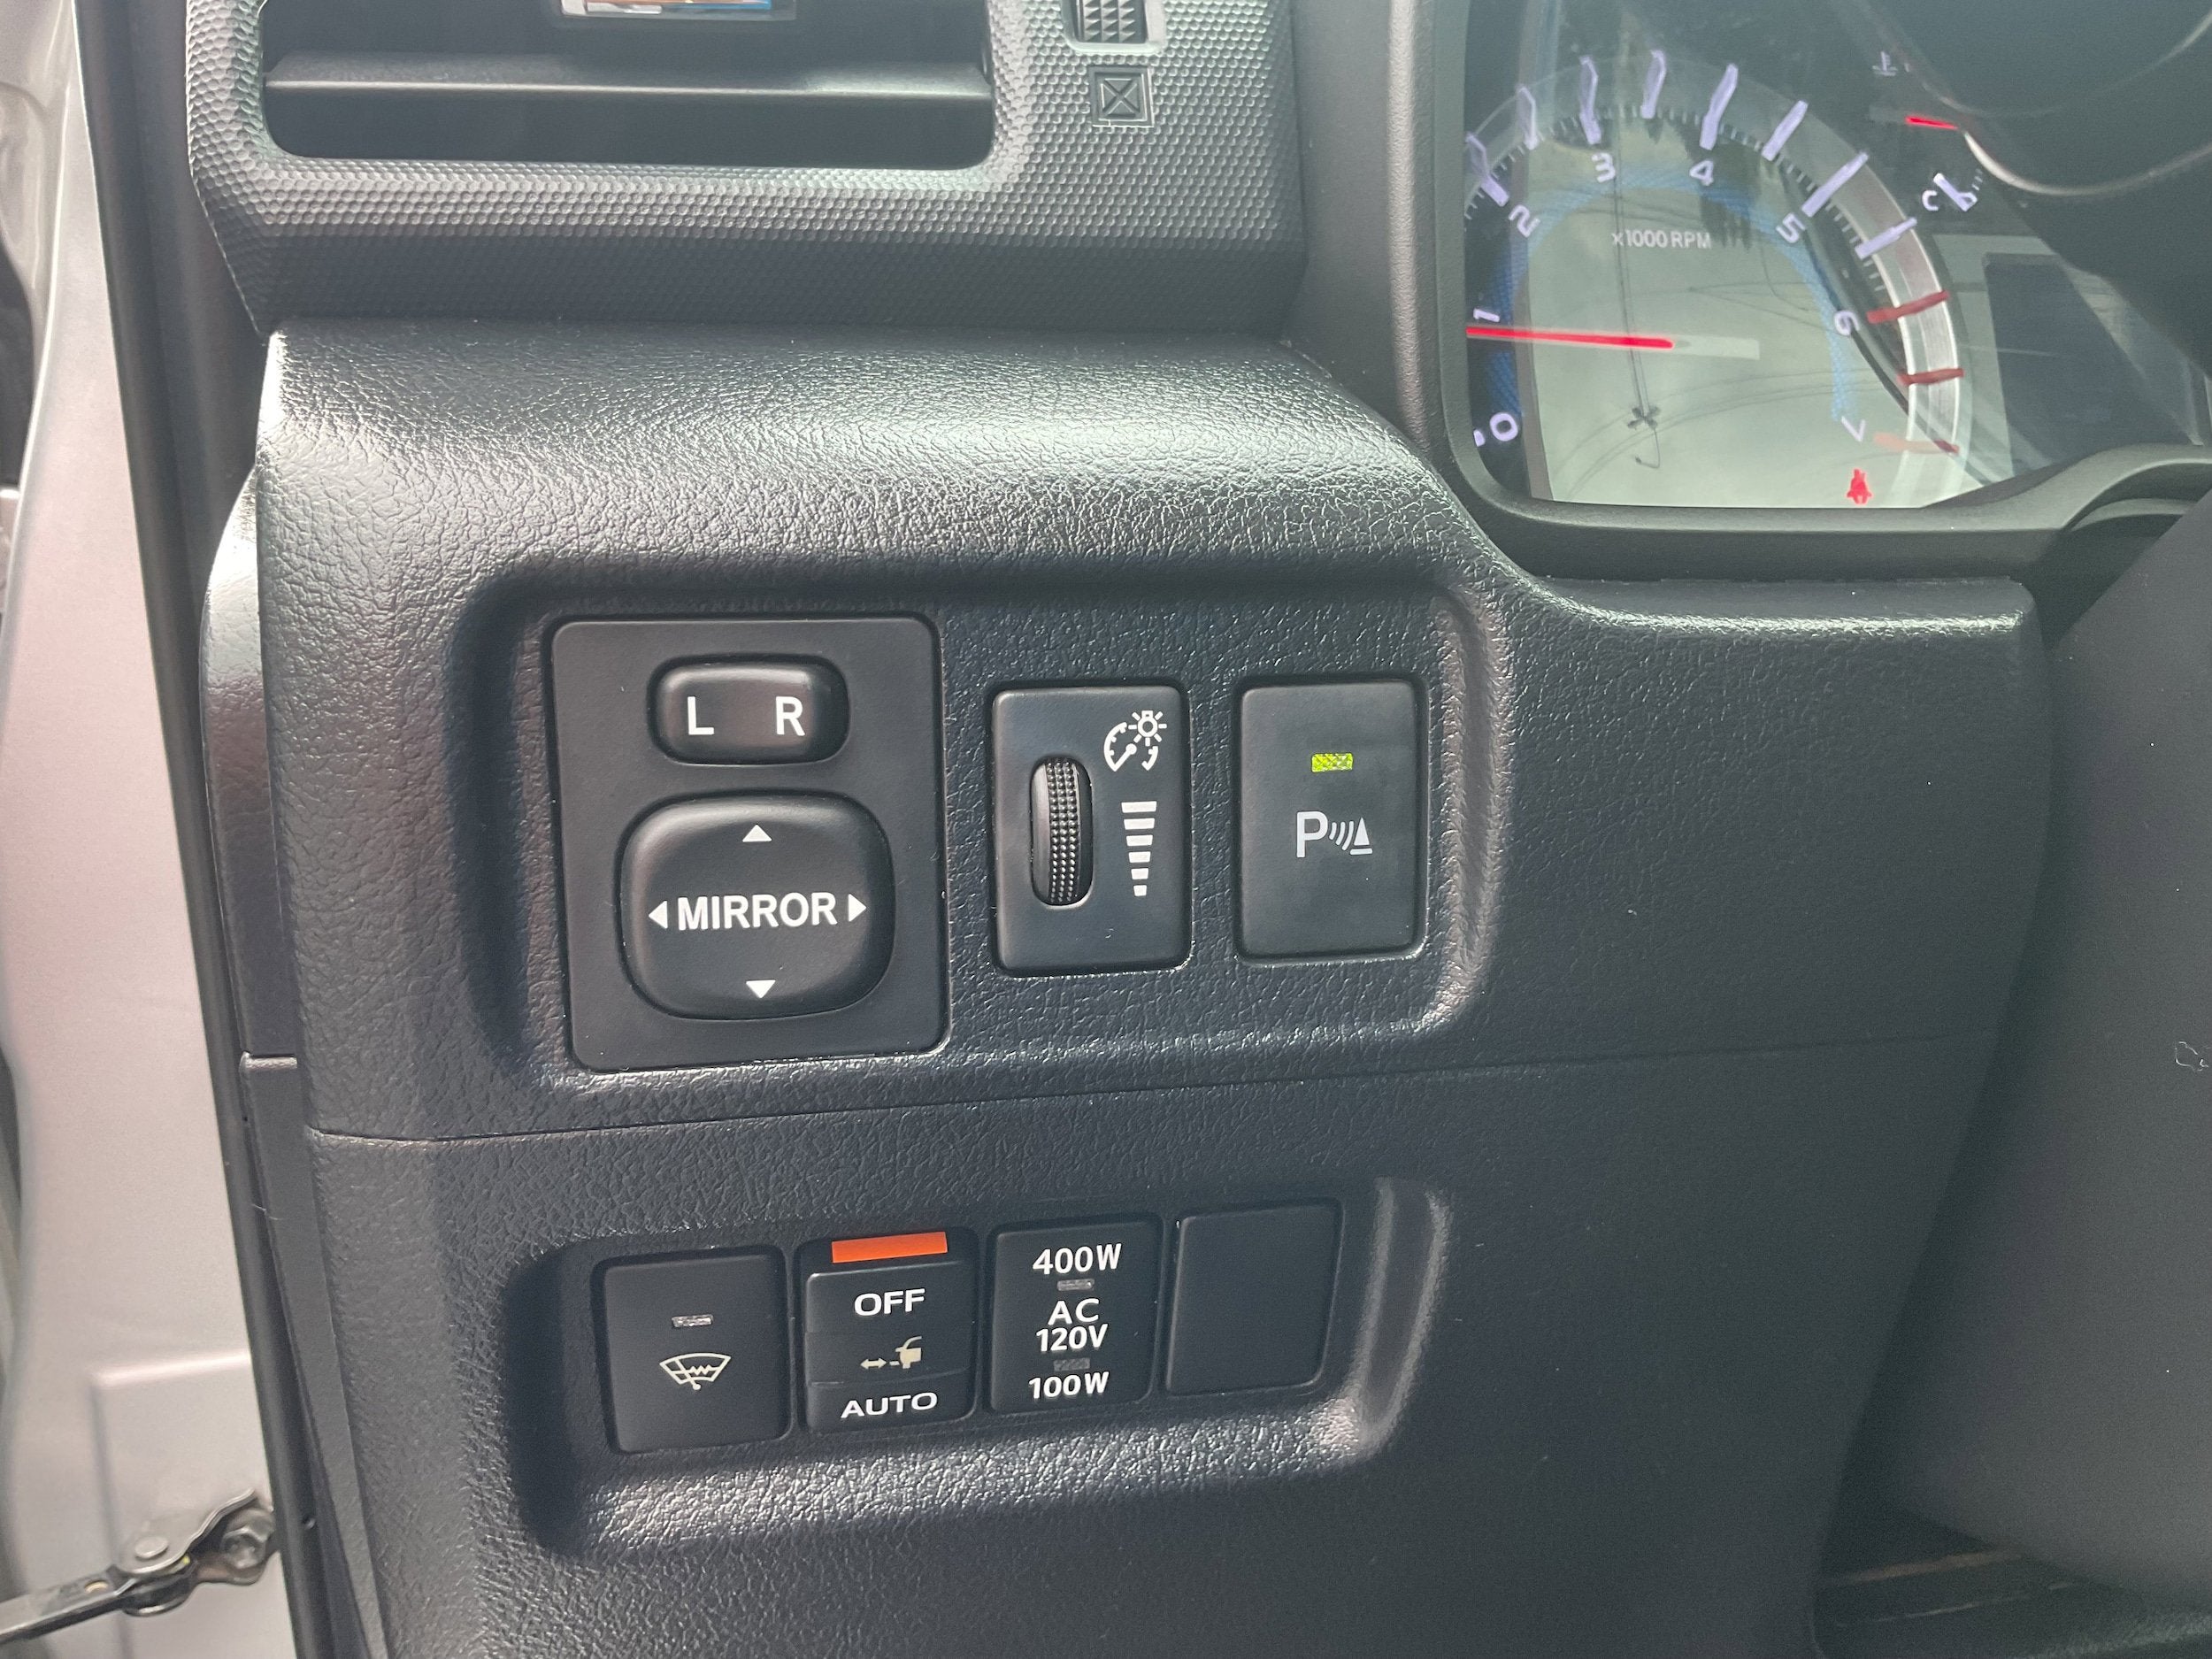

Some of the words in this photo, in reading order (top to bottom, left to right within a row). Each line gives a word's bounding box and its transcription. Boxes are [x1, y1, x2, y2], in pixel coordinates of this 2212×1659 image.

[1592, 152, 1616, 182] 3
[1690, 160, 1714, 186] 4
[1509, 204, 1540, 237] 2
[1776, 212, 1806, 243] 5
[1671, 231, 1711, 249] RPM
[1473, 309, 1500, 322] 1
[1834, 311, 1859, 335] 6
[1489, 412, 1518, 442] 0
[1841, 416, 1866, 442] 7
[687, 696, 714, 735] L
[775, 695, 805, 736] R
[1296, 810, 1327, 857] P
[678, 892, 838, 931] MIRROR
[1033, 1243, 1122, 1275] 400W
[854, 1288, 926, 1316] OFF
[1048, 1298, 1100, 1325] AC
[1036, 1324, 1109, 1352] 120V
[1028, 1371, 1110, 1399] 100W
[841, 1392, 938, 1418] AUTO
